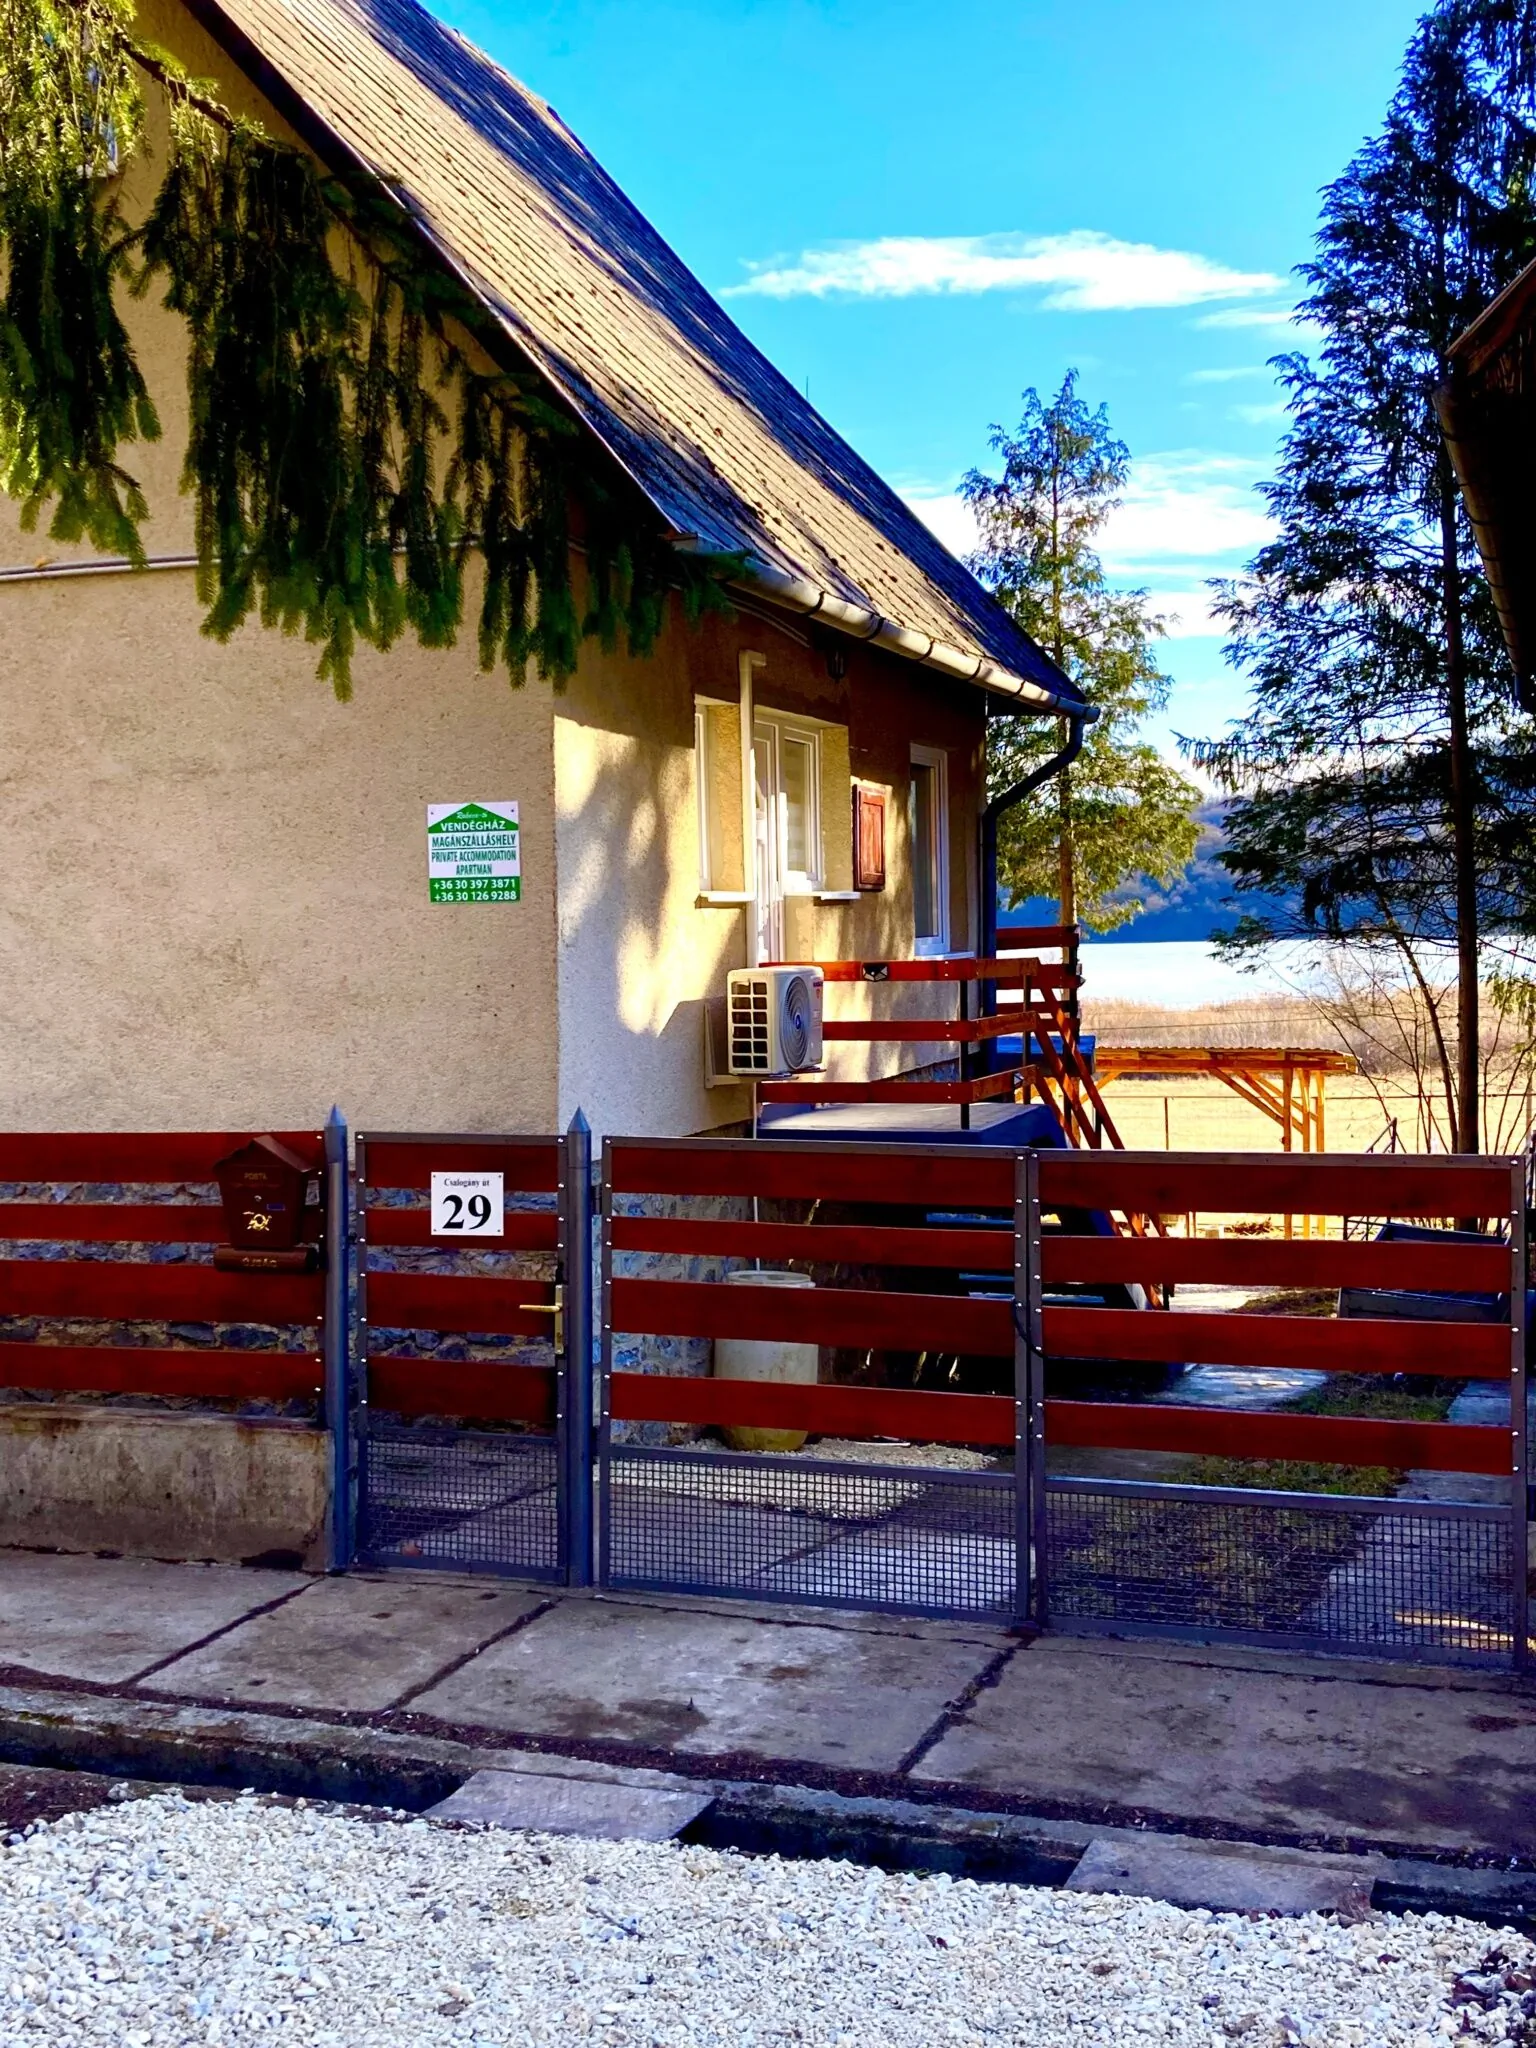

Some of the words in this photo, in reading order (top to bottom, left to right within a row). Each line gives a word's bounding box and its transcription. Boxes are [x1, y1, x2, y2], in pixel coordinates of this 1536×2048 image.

[440, 820, 506, 832] VENDÉGHÁZ
[432, 834, 516, 847] MAGÁNSZÁLLÁSHELY
[431, 851, 458, 863] PRIVATE
[459, 850, 517, 862] ACCOMMODATION
[455, 864, 493, 875] APARTMAN
[433, 880, 453, 890] +36
[455, 879, 468, 889] 30
[469, 879, 489, 889] 397
[491, 878, 516, 888] 3871
[434, 892, 454, 902] +36
[455, 891, 468, 901] 30
[471, 891, 489, 900] 126
[490, 890, 517, 900] 9288
[443, 1177, 480, 1188] Csalogány
[442, 1194, 492, 1230] 29
